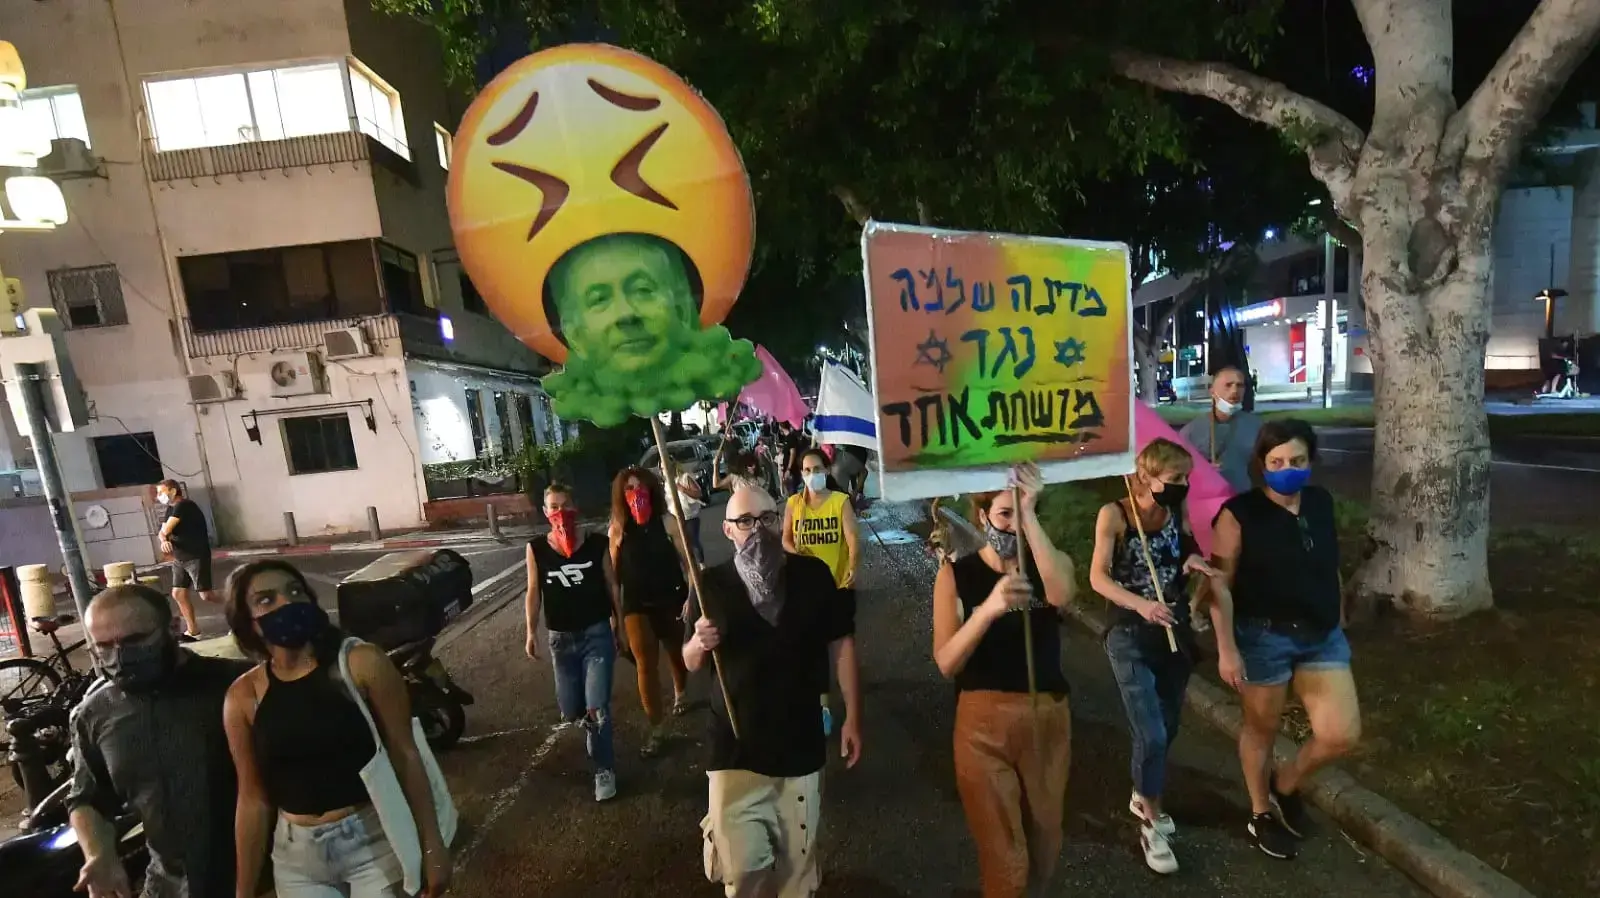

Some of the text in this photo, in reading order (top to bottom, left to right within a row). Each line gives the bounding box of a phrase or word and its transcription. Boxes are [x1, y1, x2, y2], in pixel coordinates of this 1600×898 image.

[889, 266, 1107, 317] מדינה שלמה
[960, 326, 1036, 379] נגד
[882, 385, 1105, 448] מושחת אחד
[800, 532, 839, 545] נמאסת
